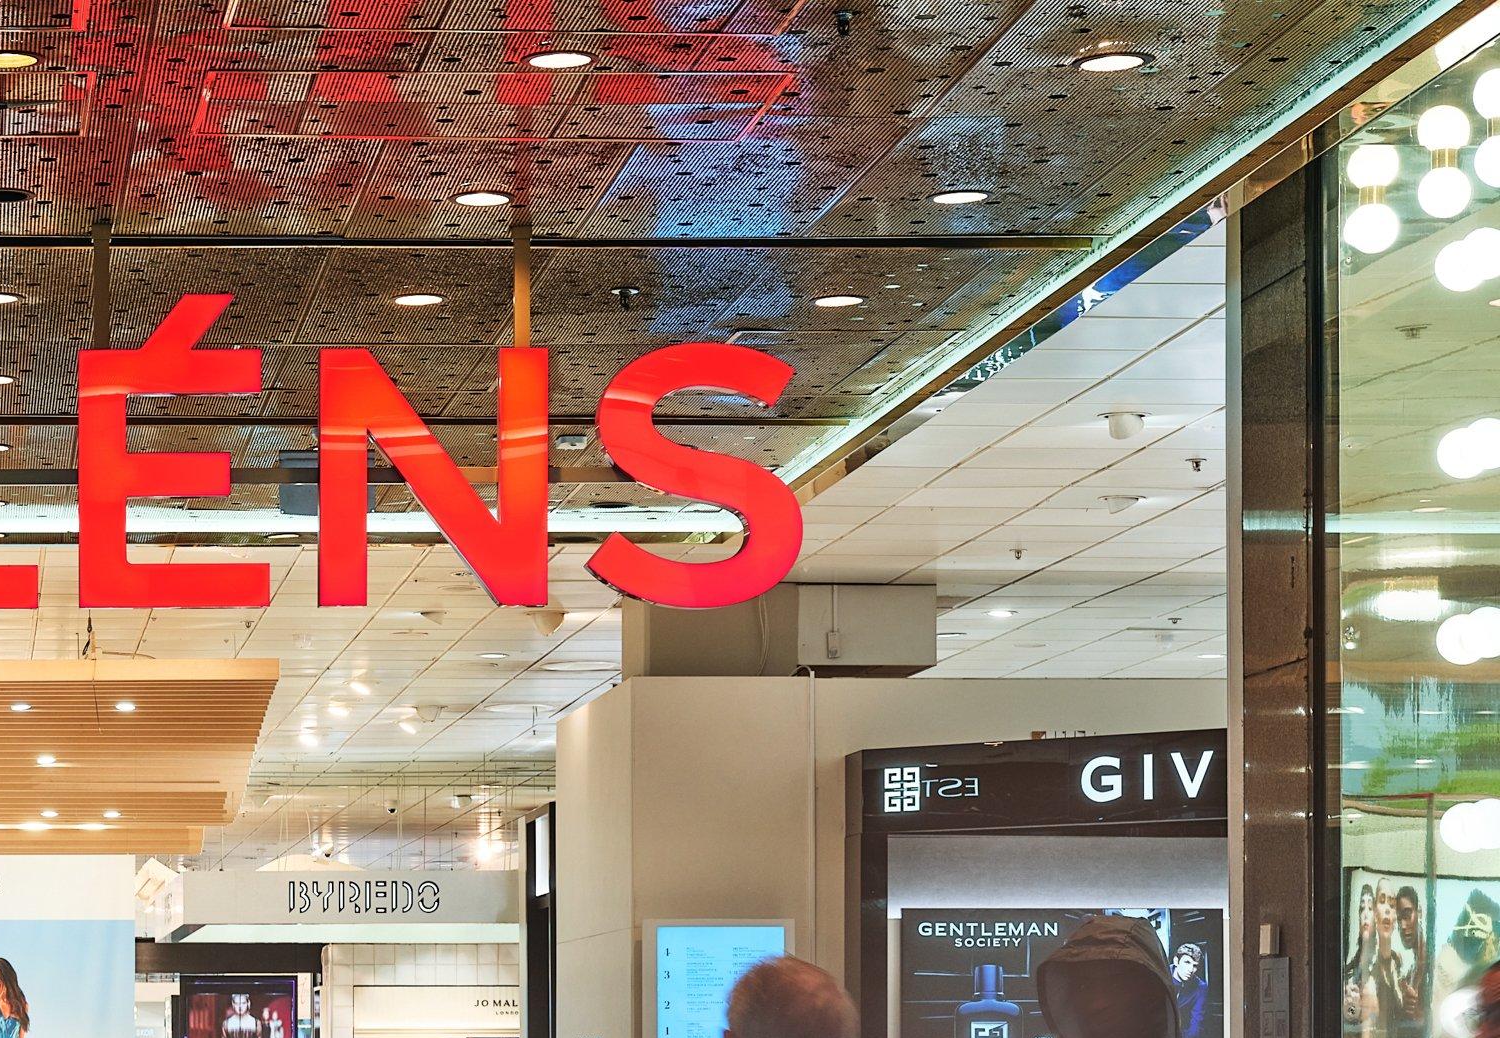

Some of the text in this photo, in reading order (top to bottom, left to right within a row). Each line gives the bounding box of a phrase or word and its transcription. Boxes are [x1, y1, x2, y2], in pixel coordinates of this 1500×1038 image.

[1080, 750, 1214, 803] GIV
[289, 880, 440, 914] BYREDO
[918, 921, 1059, 937] GENTLEMAN
[954, 937, 1022, 948] SOCIETY
[664, 970, 670, 979] 3
[474, 999, 519, 1007] JO MAL
[664, 1000, 670, 1009] 2
